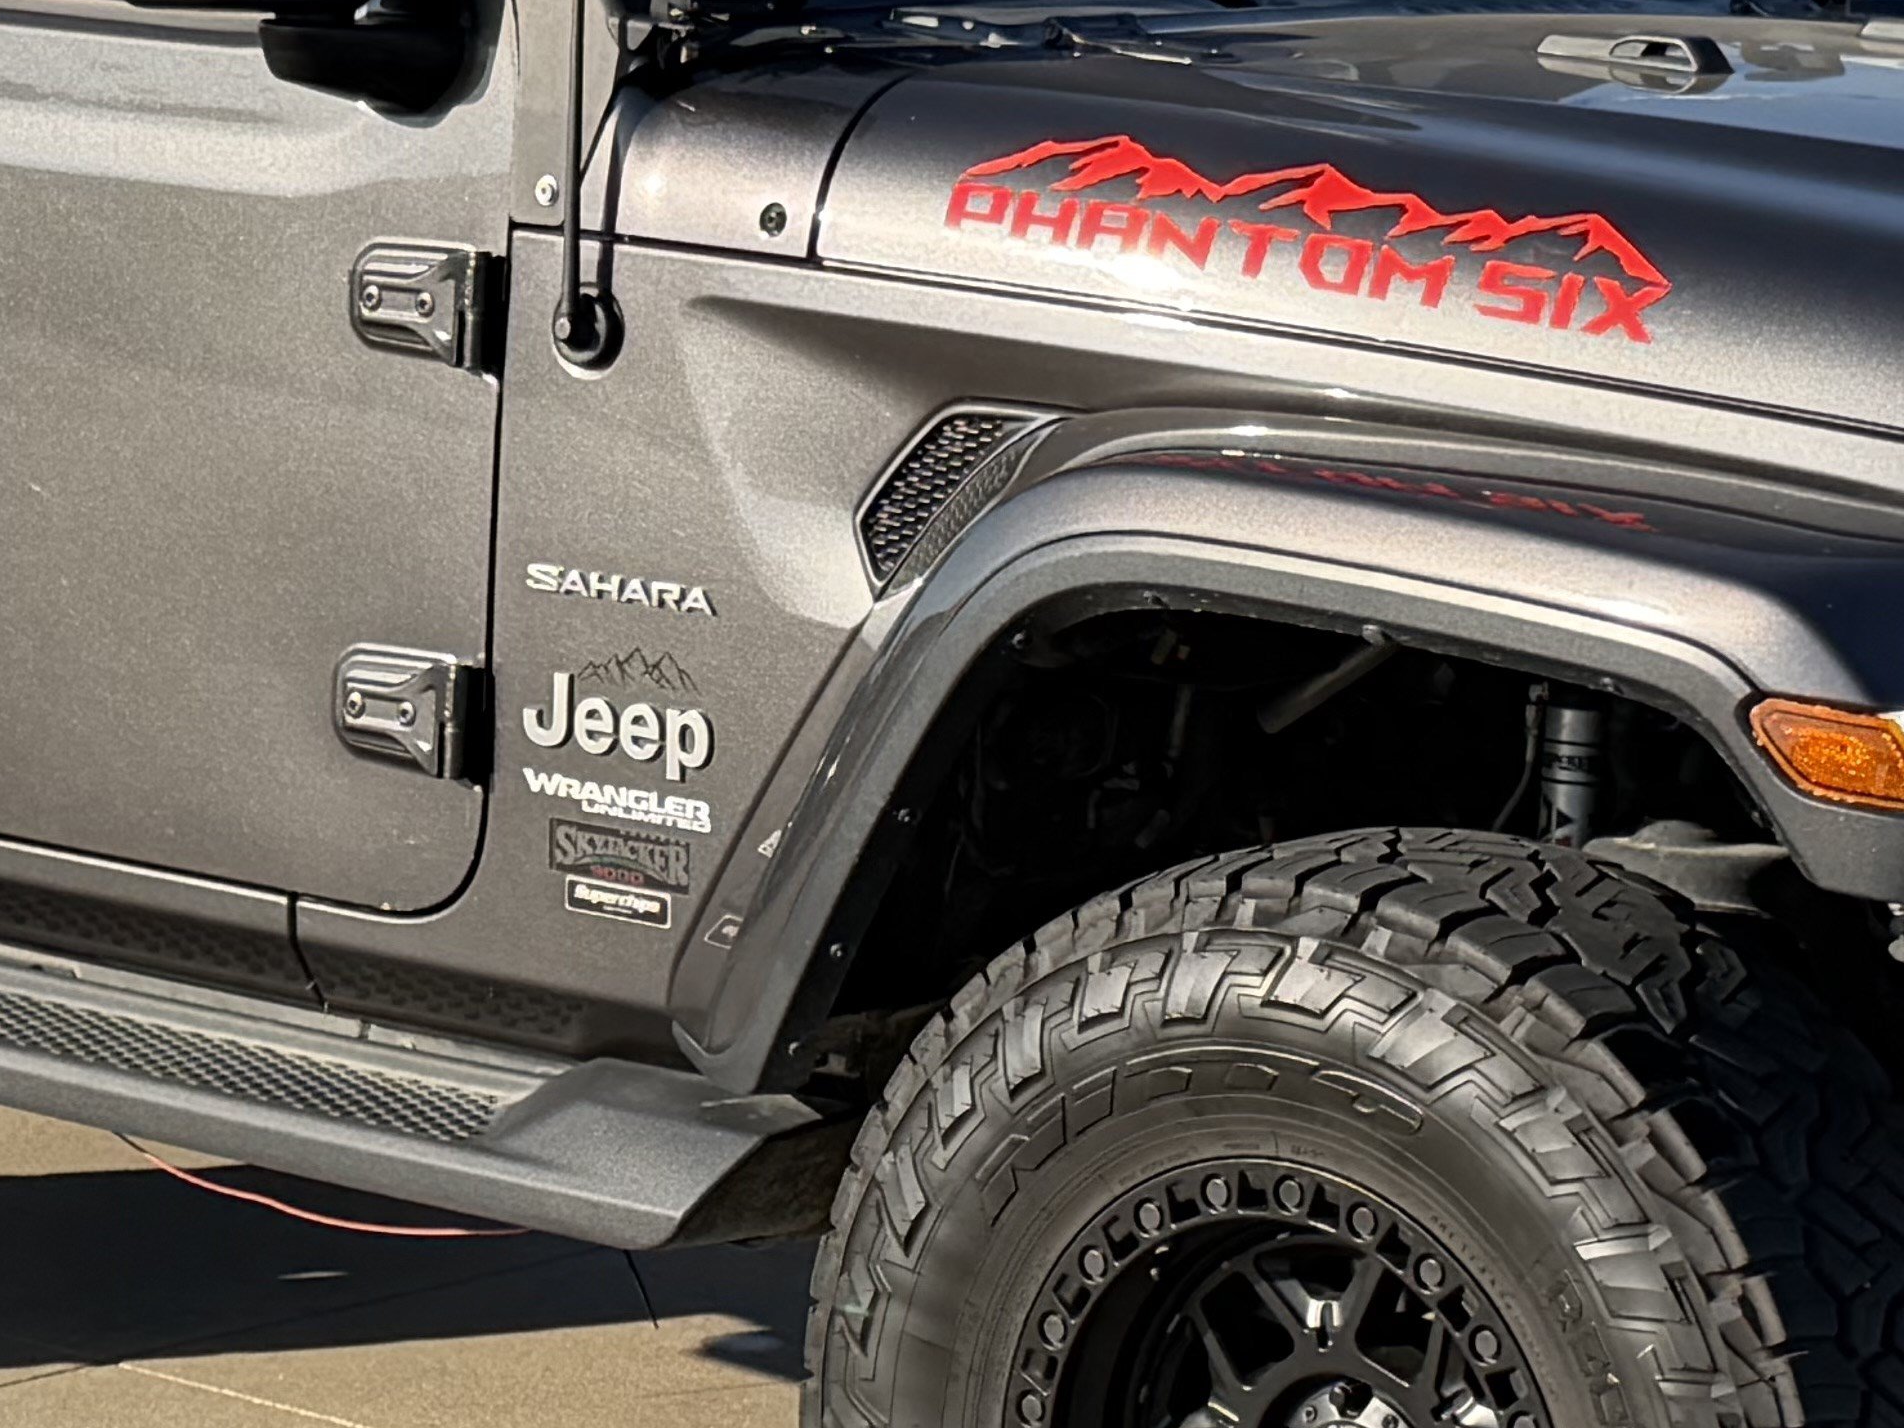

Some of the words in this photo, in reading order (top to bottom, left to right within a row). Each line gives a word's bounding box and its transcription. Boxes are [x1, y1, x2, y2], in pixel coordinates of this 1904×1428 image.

[944, 179, 1456, 309] PHANTOM
[1472, 256, 1674, 345] SIX
[525, 562, 716, 616] SAHARA
[522, 671, 714, 782] Jeep
[522, 766, 711, 818] WRANGLER
[581, 799, 712, 834] UNLIMITED
[573, 883, 661, 914] Superchips
[975, 1045, 1425, 1228] NITTO
